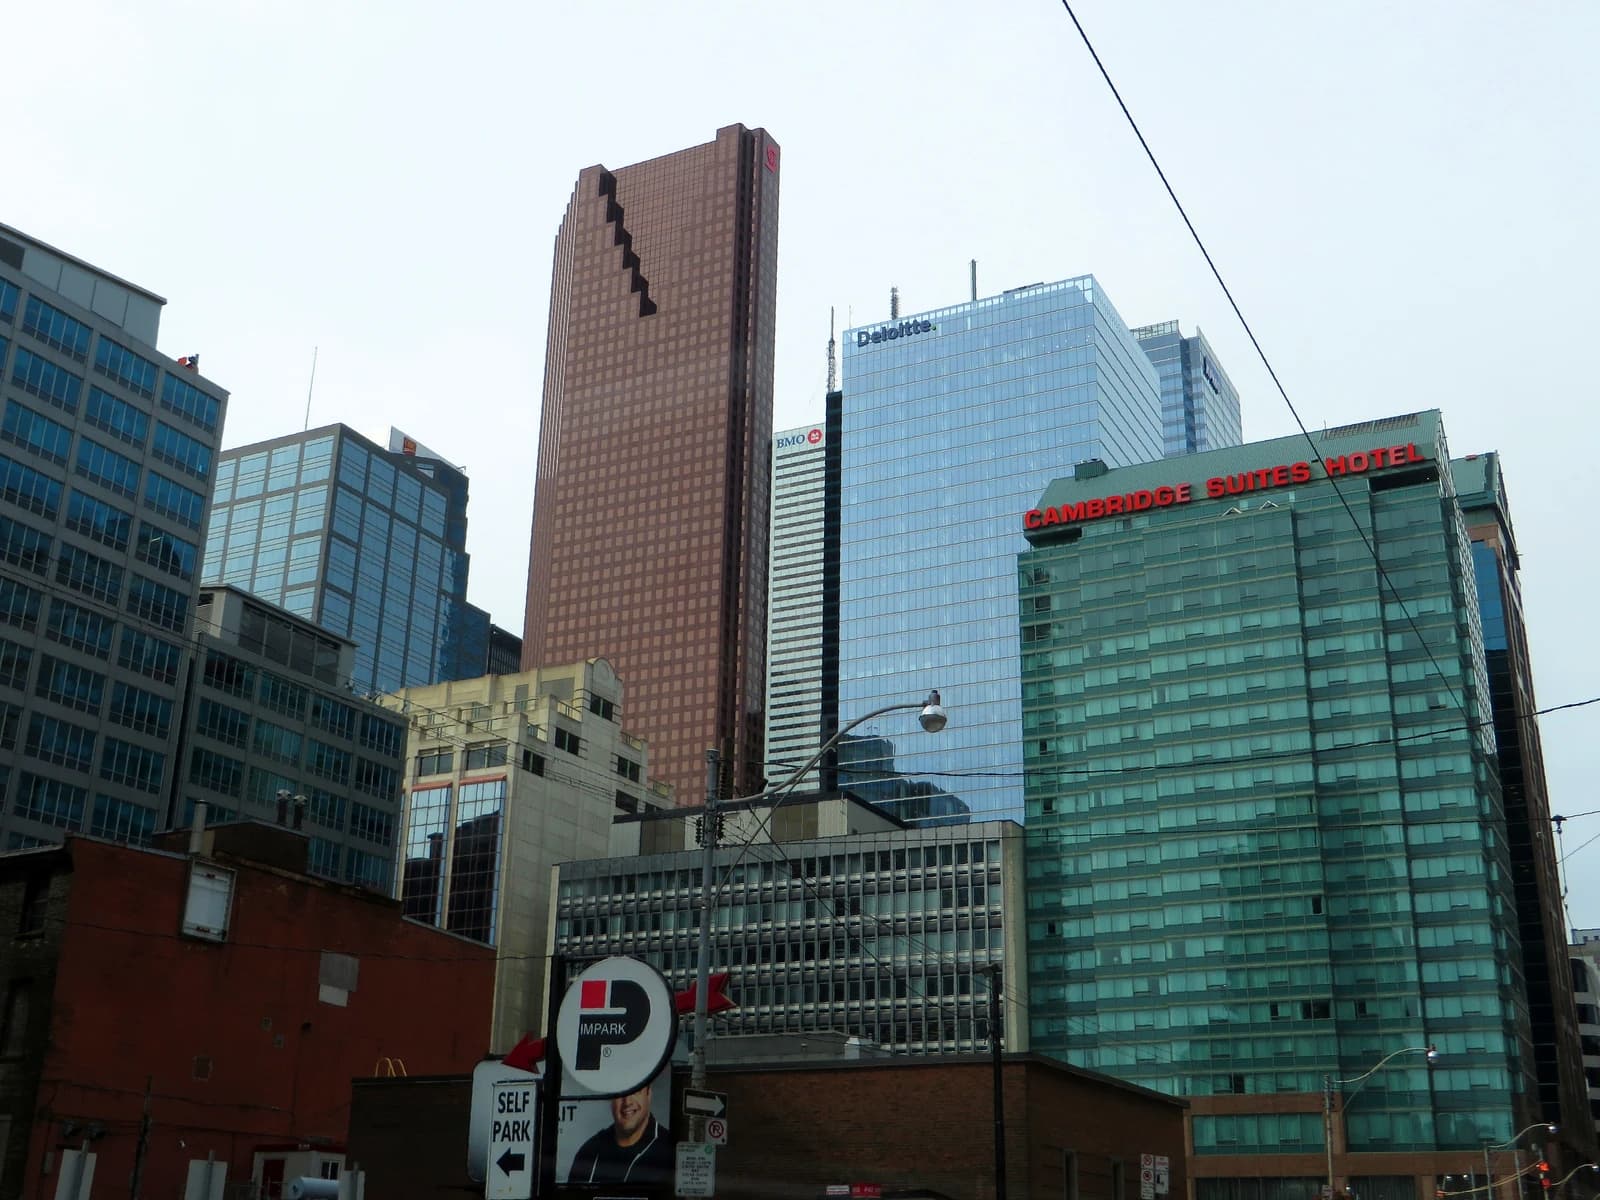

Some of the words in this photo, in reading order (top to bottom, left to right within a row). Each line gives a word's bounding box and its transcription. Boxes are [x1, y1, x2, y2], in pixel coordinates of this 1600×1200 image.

[776, 433, 806, 449] BMO
[1024, 482, 1193, 529] CAMBRIDGE
[1206, 461, 1311, 498] SUITES
[1324, 442, 1425, 477] HOTEL
[580, 1022, 626, 1036] IMPARK
[498, 1090, 530, 1114] SELF
[559, 1105, 578, 1122] IT
[492, 1119, 531, 1143] PARK
